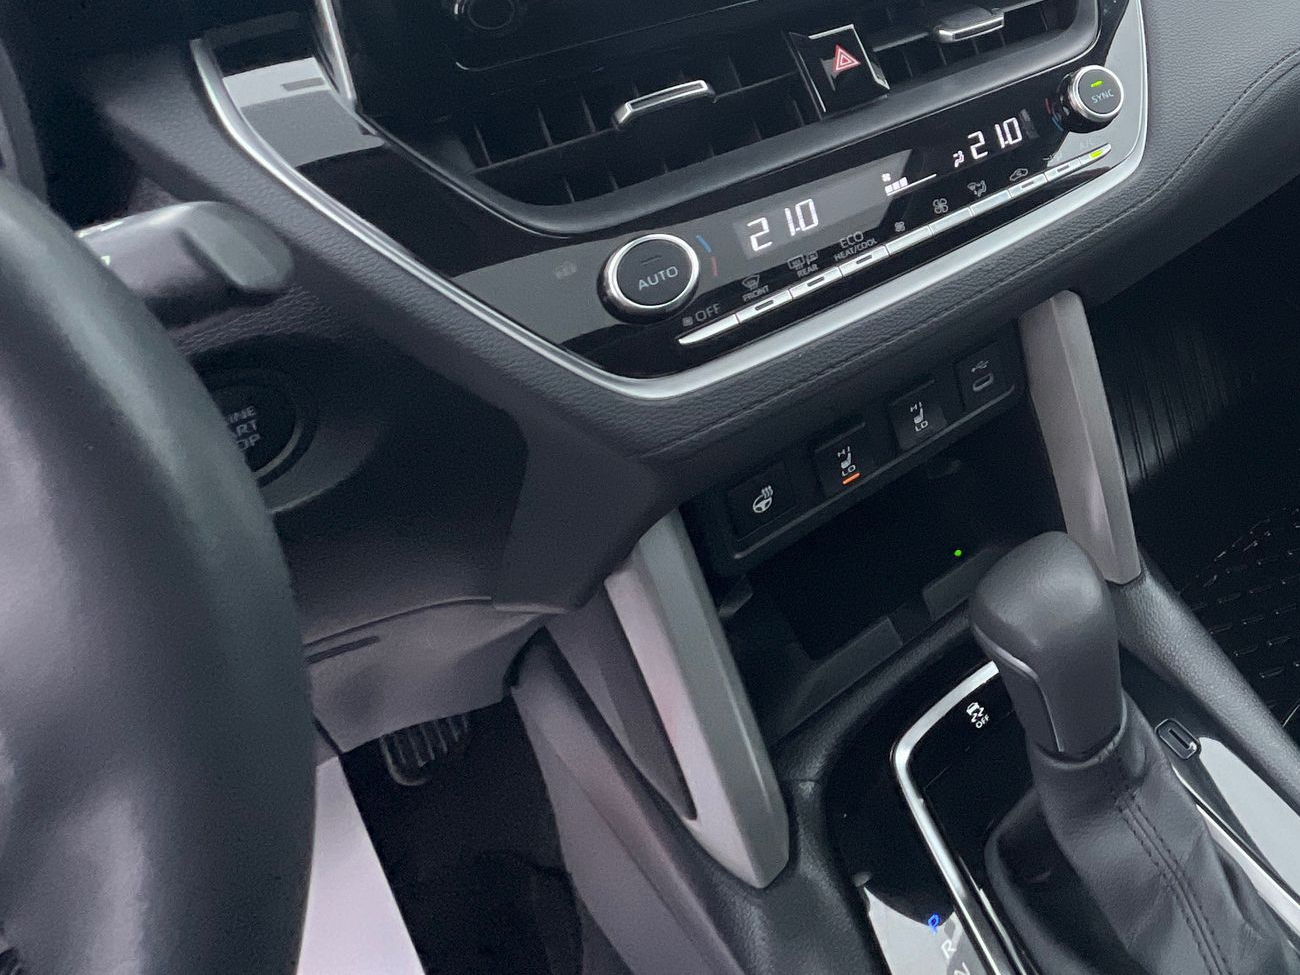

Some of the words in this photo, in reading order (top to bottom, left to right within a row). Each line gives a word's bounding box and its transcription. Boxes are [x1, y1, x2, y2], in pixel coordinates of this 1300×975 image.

[1091, 89, 1115, 104] SYNC
[840, 231, 864, 249] ECO
[833, 238, 877, 261] HEAT/COOL
[797, 263, 819, 277] REAR
[638, 265, 679, 291] AUTO
[743, 285, 769, 302] FRONT
[695, 303, 722, 322] OFF
[910, 401, 922, 413] HI
[914, 420, 928, 432] LO
[837, 446, 850, 458] HI
[842, 464, 856, 477] LO
[975, 714, 990, 729] OFF
[941, 939, 957, 959] R
